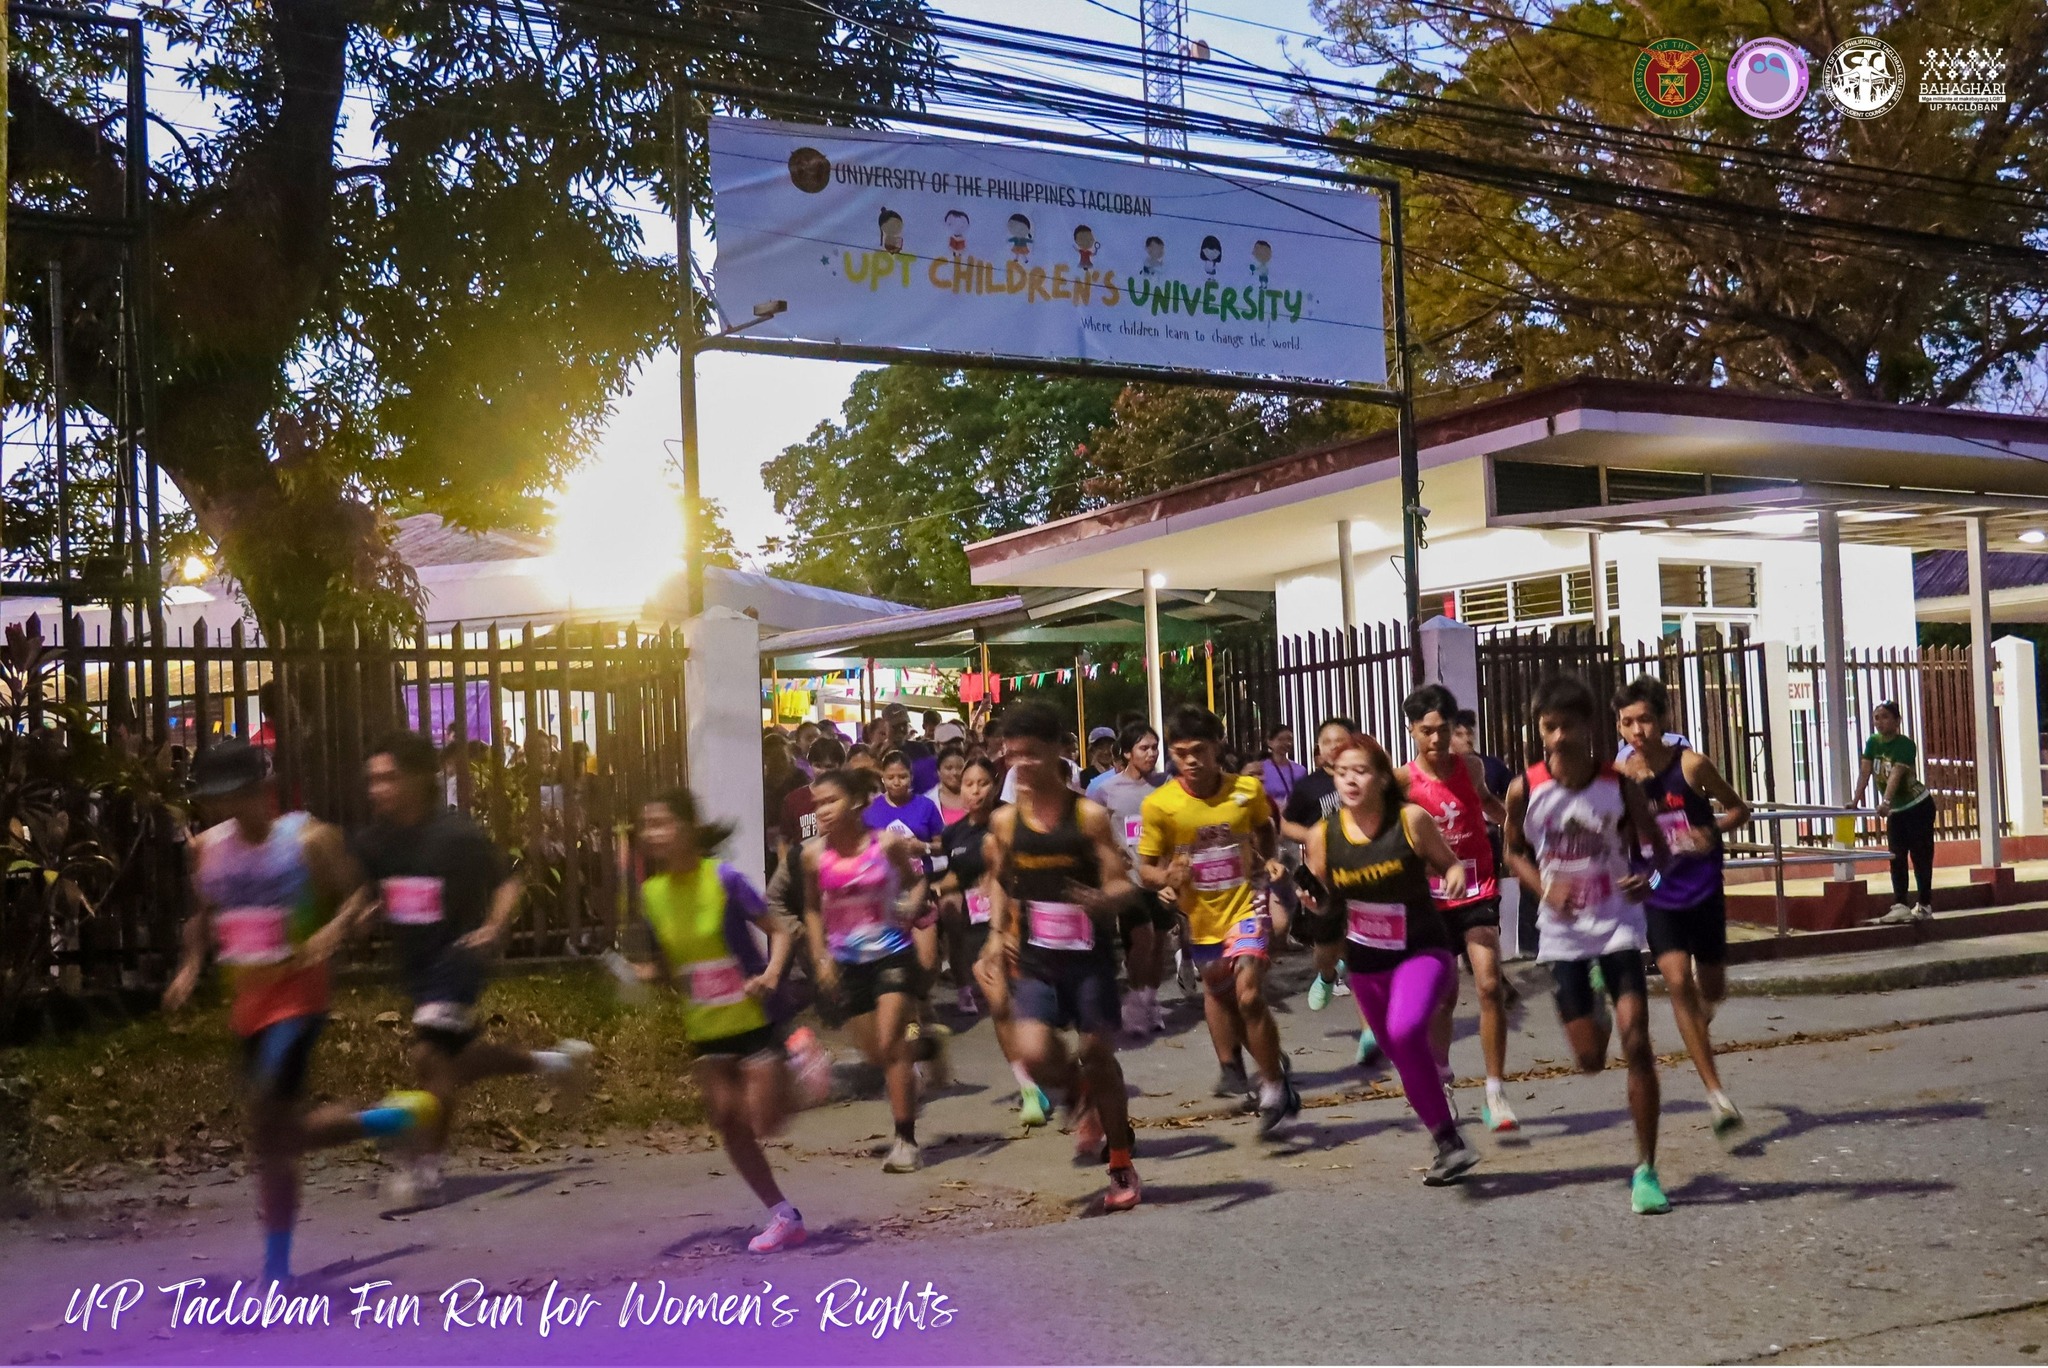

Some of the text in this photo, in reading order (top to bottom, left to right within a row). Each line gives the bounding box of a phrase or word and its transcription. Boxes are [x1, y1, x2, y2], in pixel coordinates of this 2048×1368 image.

[835, 163, 1151, 217] UNIVERSITY OF THE PHILIPPINES TACLOBAN
[843, 250, 1303, 323] UPT CHILDREN'S UNIVERSITY
[1081, 316, 1112, 333] Where
[1120, 320, 1160, 337] children
[1165, 324, 1190, 340] learn
[1196, 330, 1205, 342] to
[1212, 328, 1244, 349] change
[1250, 332, 1266, 347] the
[1788, 683, 1811, 699] EXIT
